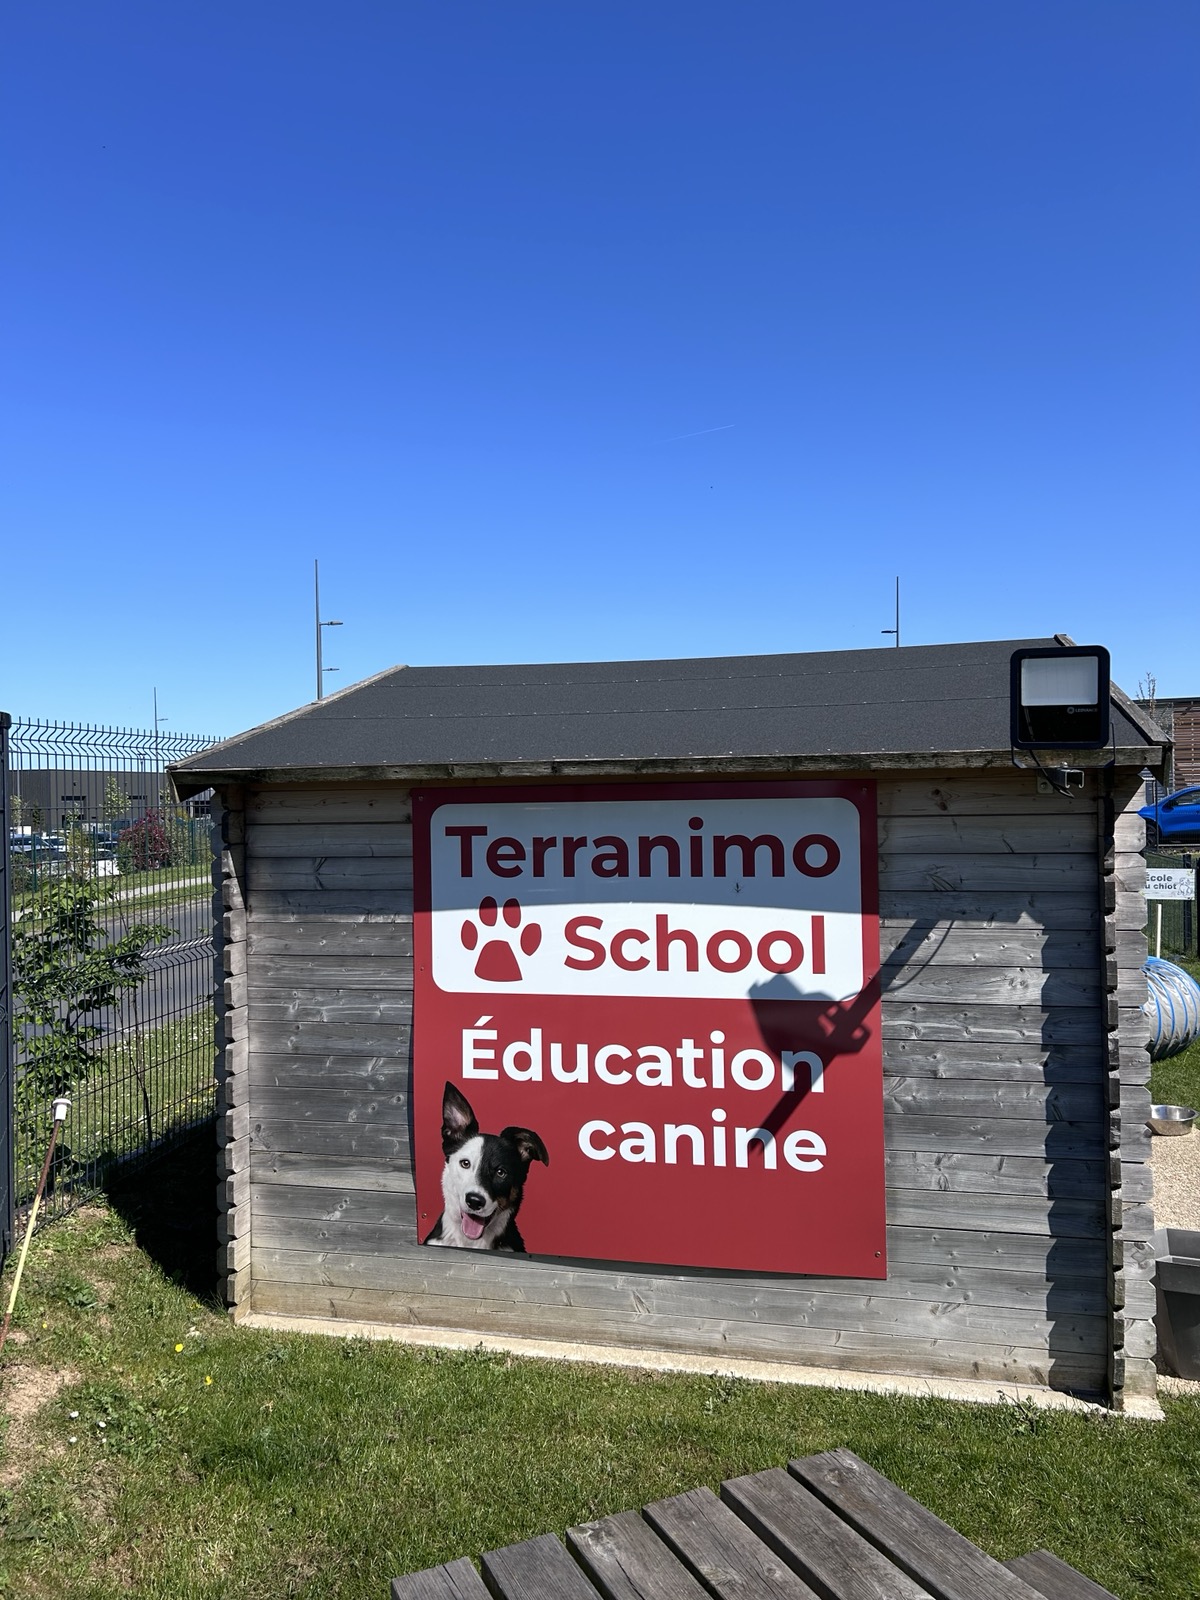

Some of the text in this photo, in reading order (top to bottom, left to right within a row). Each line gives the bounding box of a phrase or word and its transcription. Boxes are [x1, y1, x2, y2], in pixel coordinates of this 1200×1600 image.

[444, 816, 841, 879] Terranimo
[563, 913, 826, 975] School
[461, 1015, 825, 1094] Éducation
[577, 1108, 828, 1173] canine
